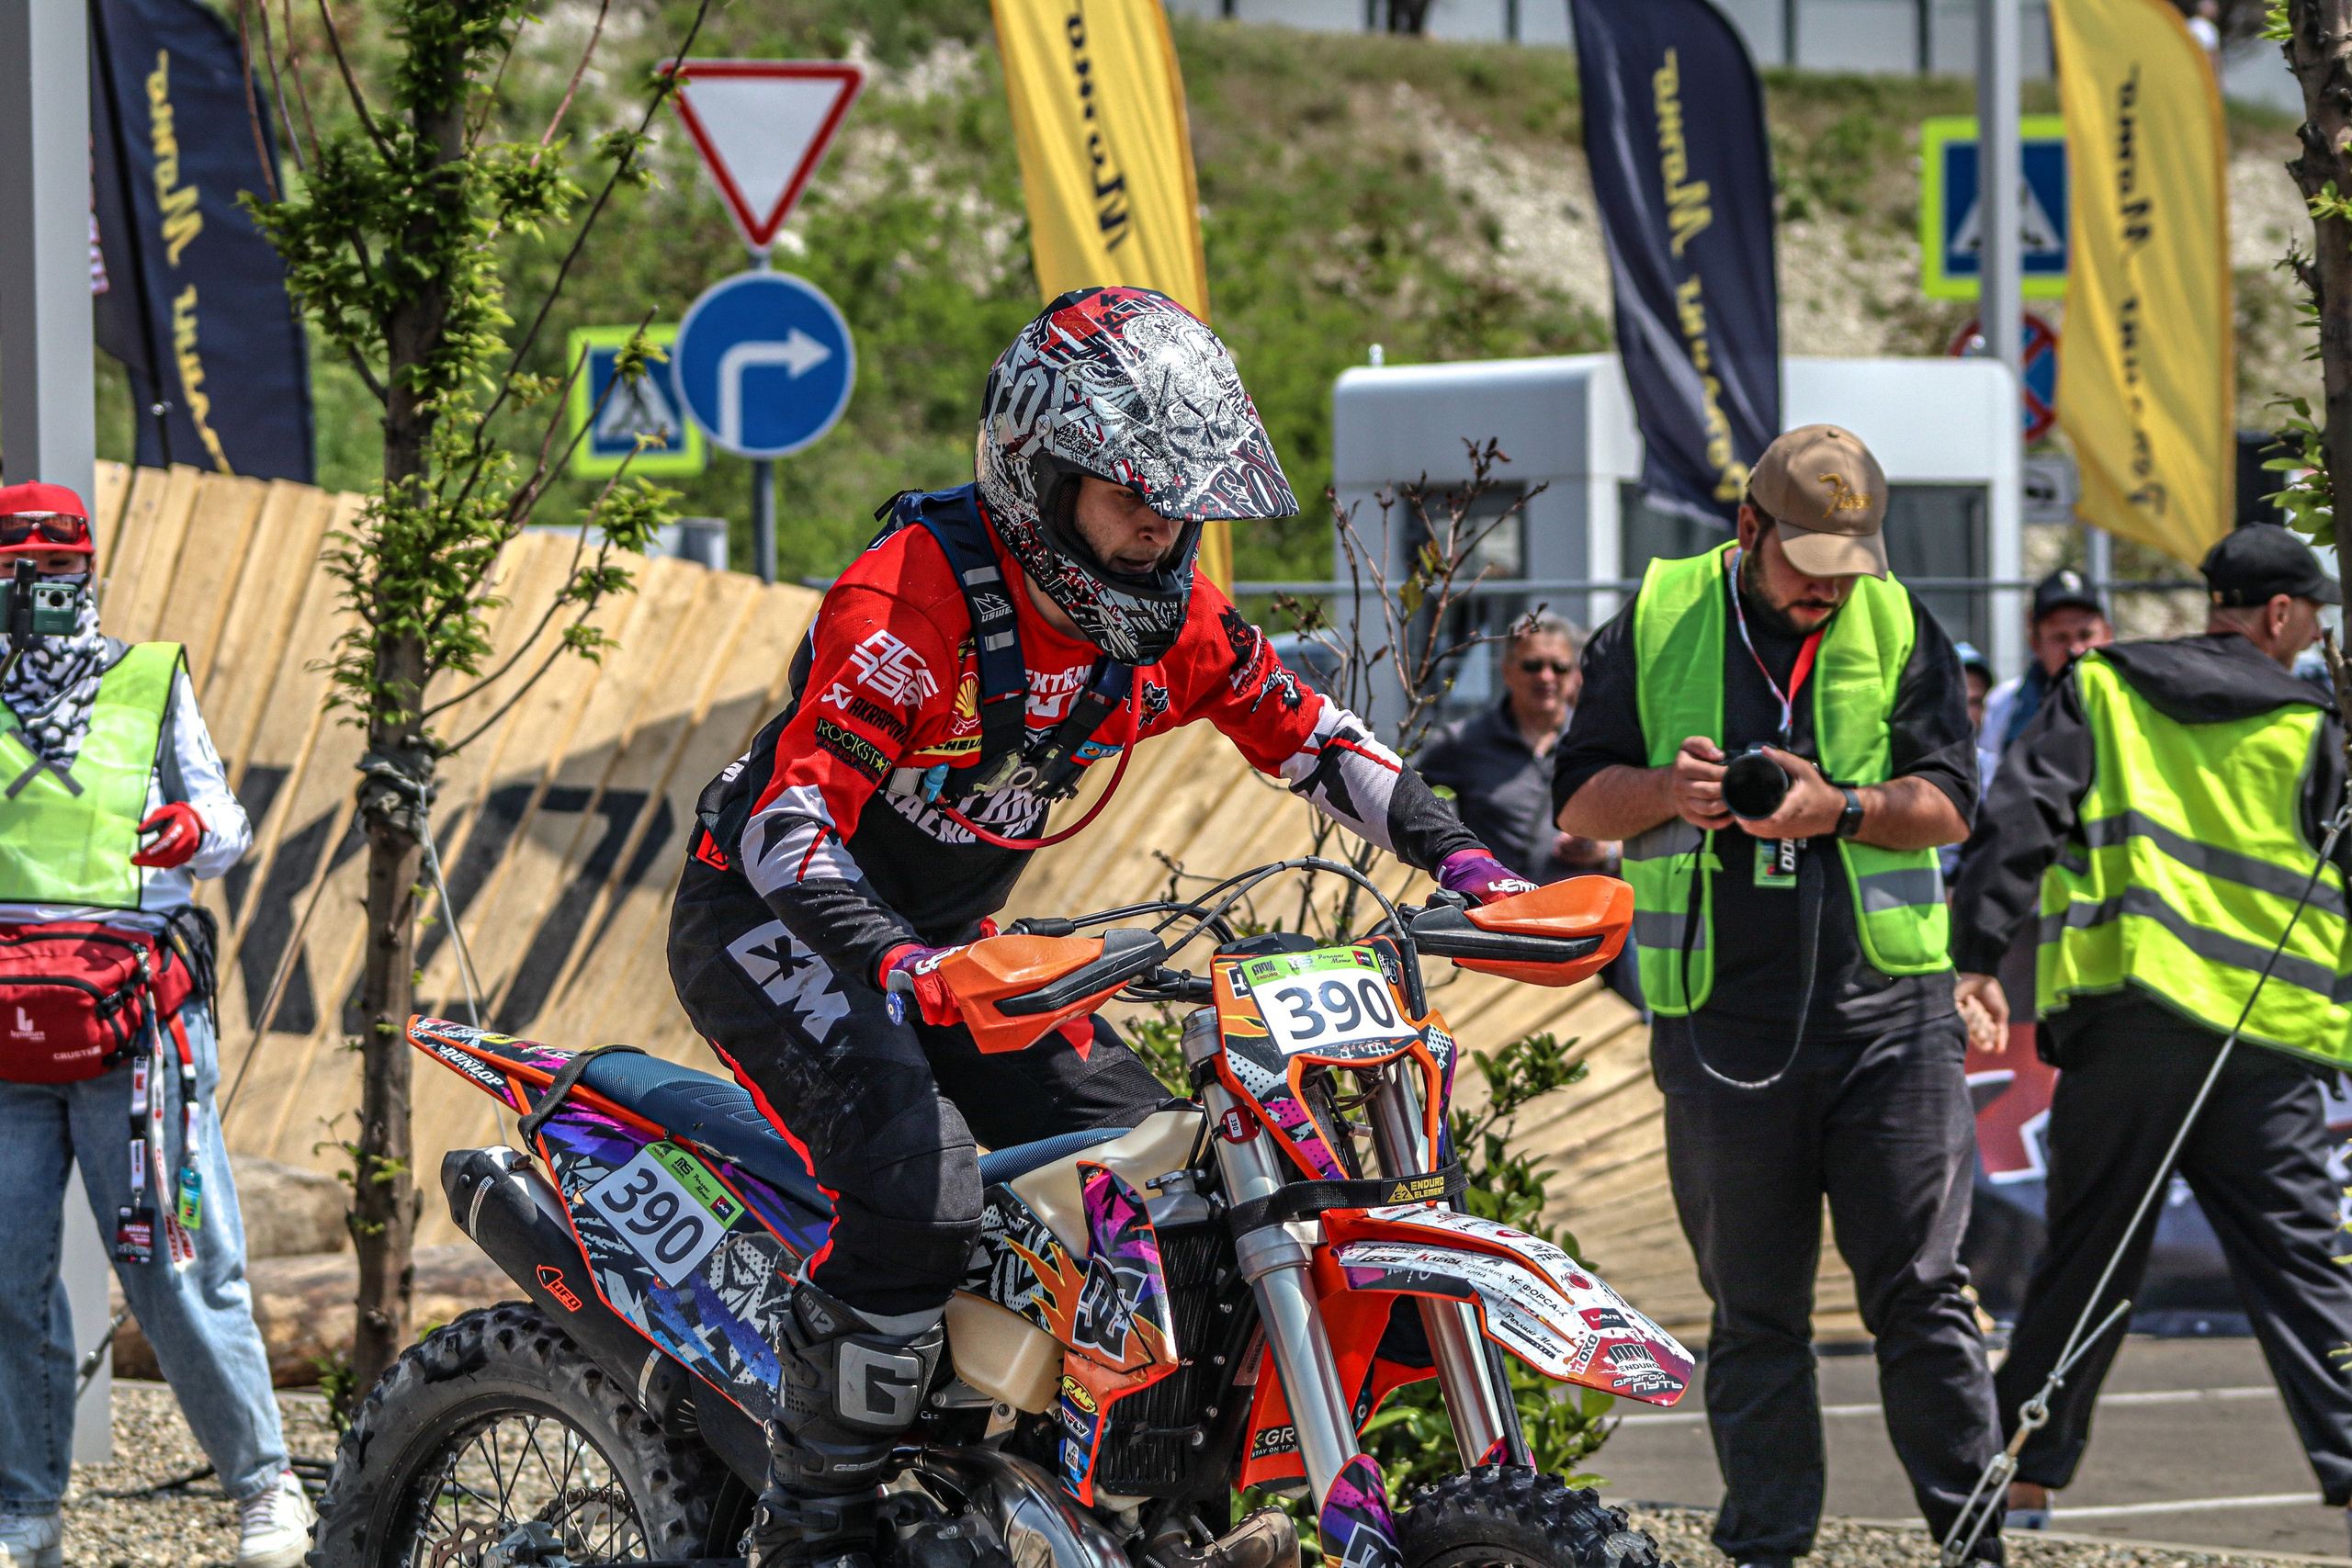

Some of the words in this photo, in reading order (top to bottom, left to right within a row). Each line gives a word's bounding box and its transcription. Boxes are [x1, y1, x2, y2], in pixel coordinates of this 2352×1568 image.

[981, 608, 1012, 623] USWE
[1255, 971, 1279, 981] ENDURO
[1274, 978, 1395, 1040] 390
[440, 1045, 505, 1087] DUNLOP
[1229, 1118, 1238, 1132] 390
[1409, 1176, 1445, 1191] ENDURO
[1414, 1186, 1445, 1199] ELEMENT
[601, 1168, 704, 1264] 390
[124, 1224, 151, 1233] MEDIA
[1429, 1255, 1463, 1266] KENDA
[1589, 1313, 1622, 1322] LAVR
[1618, 1362, 1661, 1373] ENDURO
[1612, 1372, 1667, 1388] ДРУГОЙ
[1632, 1381, 1685, 1393] ПУТЬ
[1063, 1377, 1096, 1407] FMF
[1251, 1448, 1268, 1459] STAY
[1269, 1445, 1280, 1454] ON
